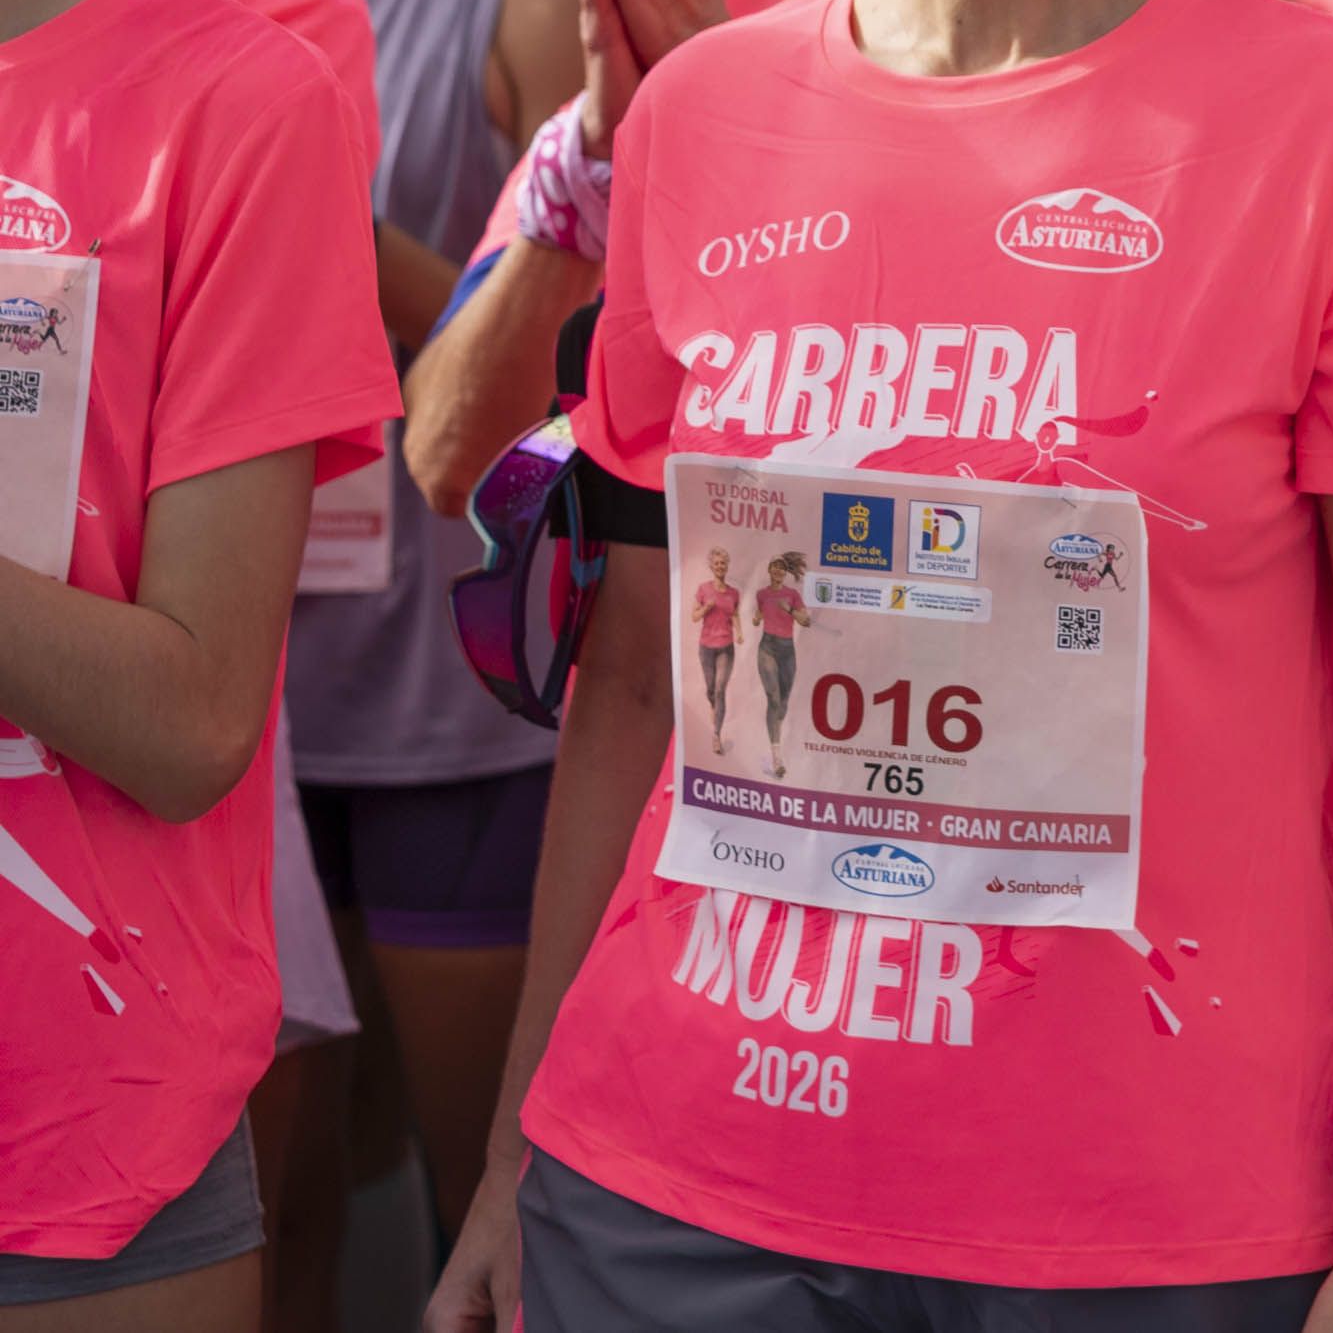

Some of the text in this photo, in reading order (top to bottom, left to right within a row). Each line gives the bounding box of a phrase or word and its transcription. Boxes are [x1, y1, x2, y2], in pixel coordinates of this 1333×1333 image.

[700, 210, 851, 277] OYSHO
[1006, 215, 1149, 258] ASTURIANA
[679, 323, 1078, 446] CARRERA
[705, 481, 789, 506] TU DORSAL
[710, 499, 790, 534] SUMA
[826, 551, 888, 567] Gran Canaria
[831, 542, 881, 556] Cabildo de
[810, 673, 984, 753] 016
[803, 741, 968, 767] TELÉFONO VIOLENCIA DE GÉNERO
[863, 762, 924, 796] 765
[692, 777, 1112, 845] CARRERA DE LA MUJER GRAN CANARIA
[712, 840, 786, 872] OYSHO
[839, 858, 927, 888] ASTURIANA
[1007, 879, 1086, 896] Santander
[671, 888, 985, 1046] MUJER
[733, 1037, 850, 1118] 2026
